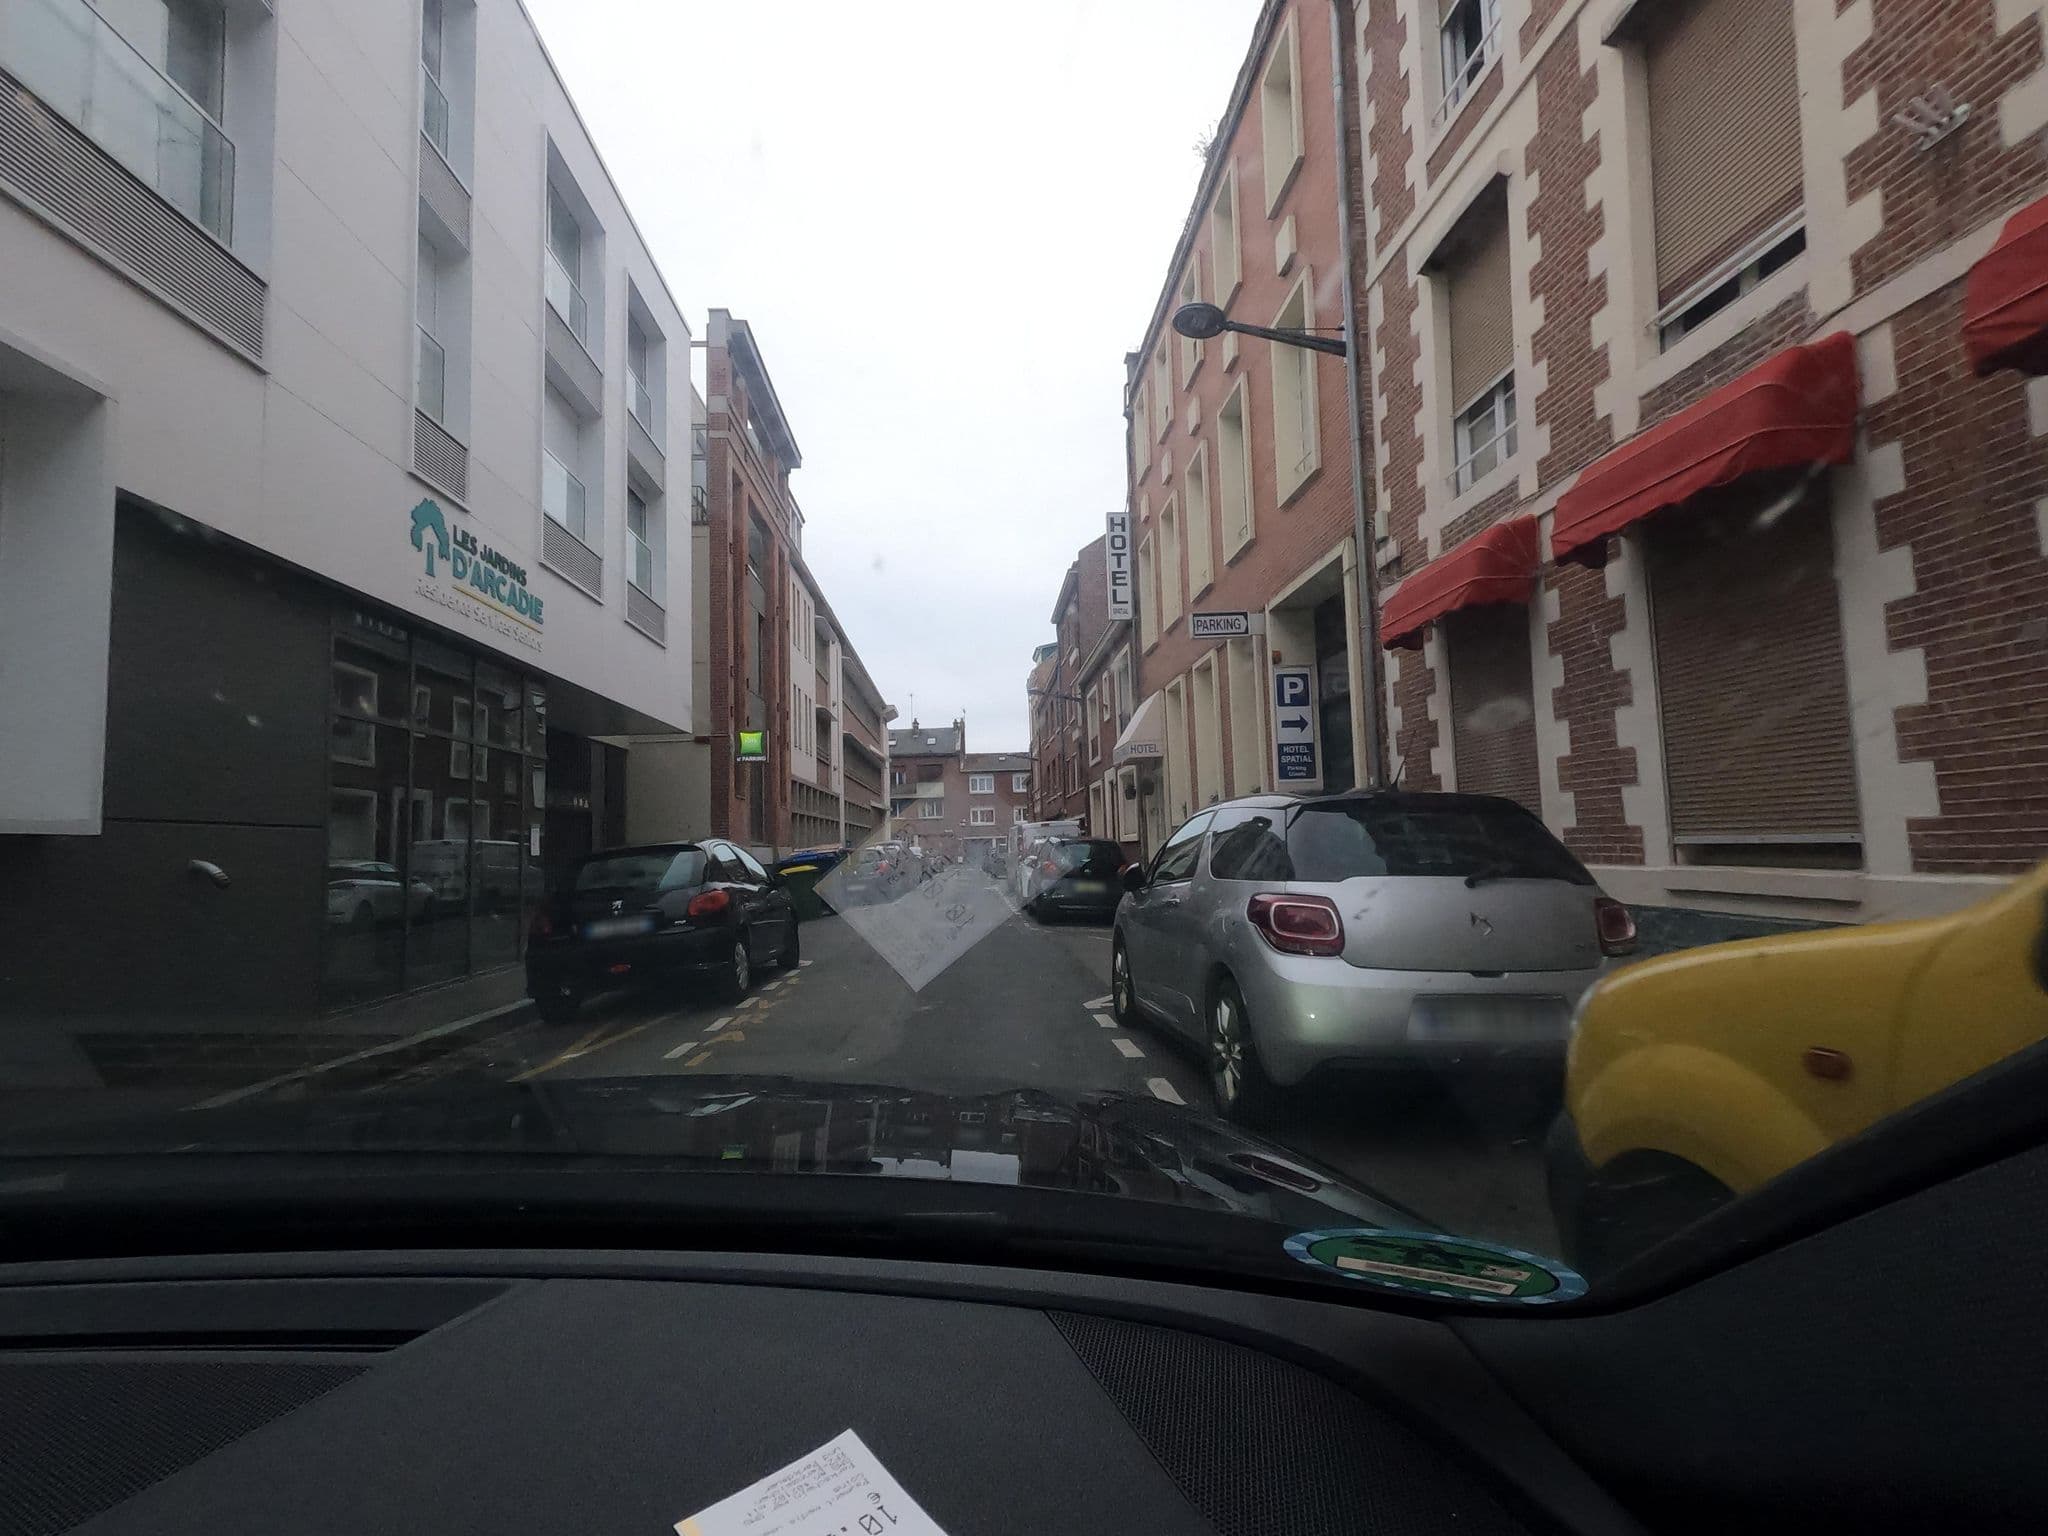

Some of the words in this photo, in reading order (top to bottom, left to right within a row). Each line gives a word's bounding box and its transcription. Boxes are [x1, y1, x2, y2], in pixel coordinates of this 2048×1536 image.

[453, 524, 478, 556] LES
[480, 544, 527, 587] JARDINS
[1110, 516, 1129, 604] HOTEL
[452, 547, 544, 625] D'ARCADIE
[1195, 617, 1242, 634] PARKING
[1284, 677, 1304, 704] P
[1130, 744, 1159, 754] HOTEL
[1281, 755, 1312, 763] SPATIAL
